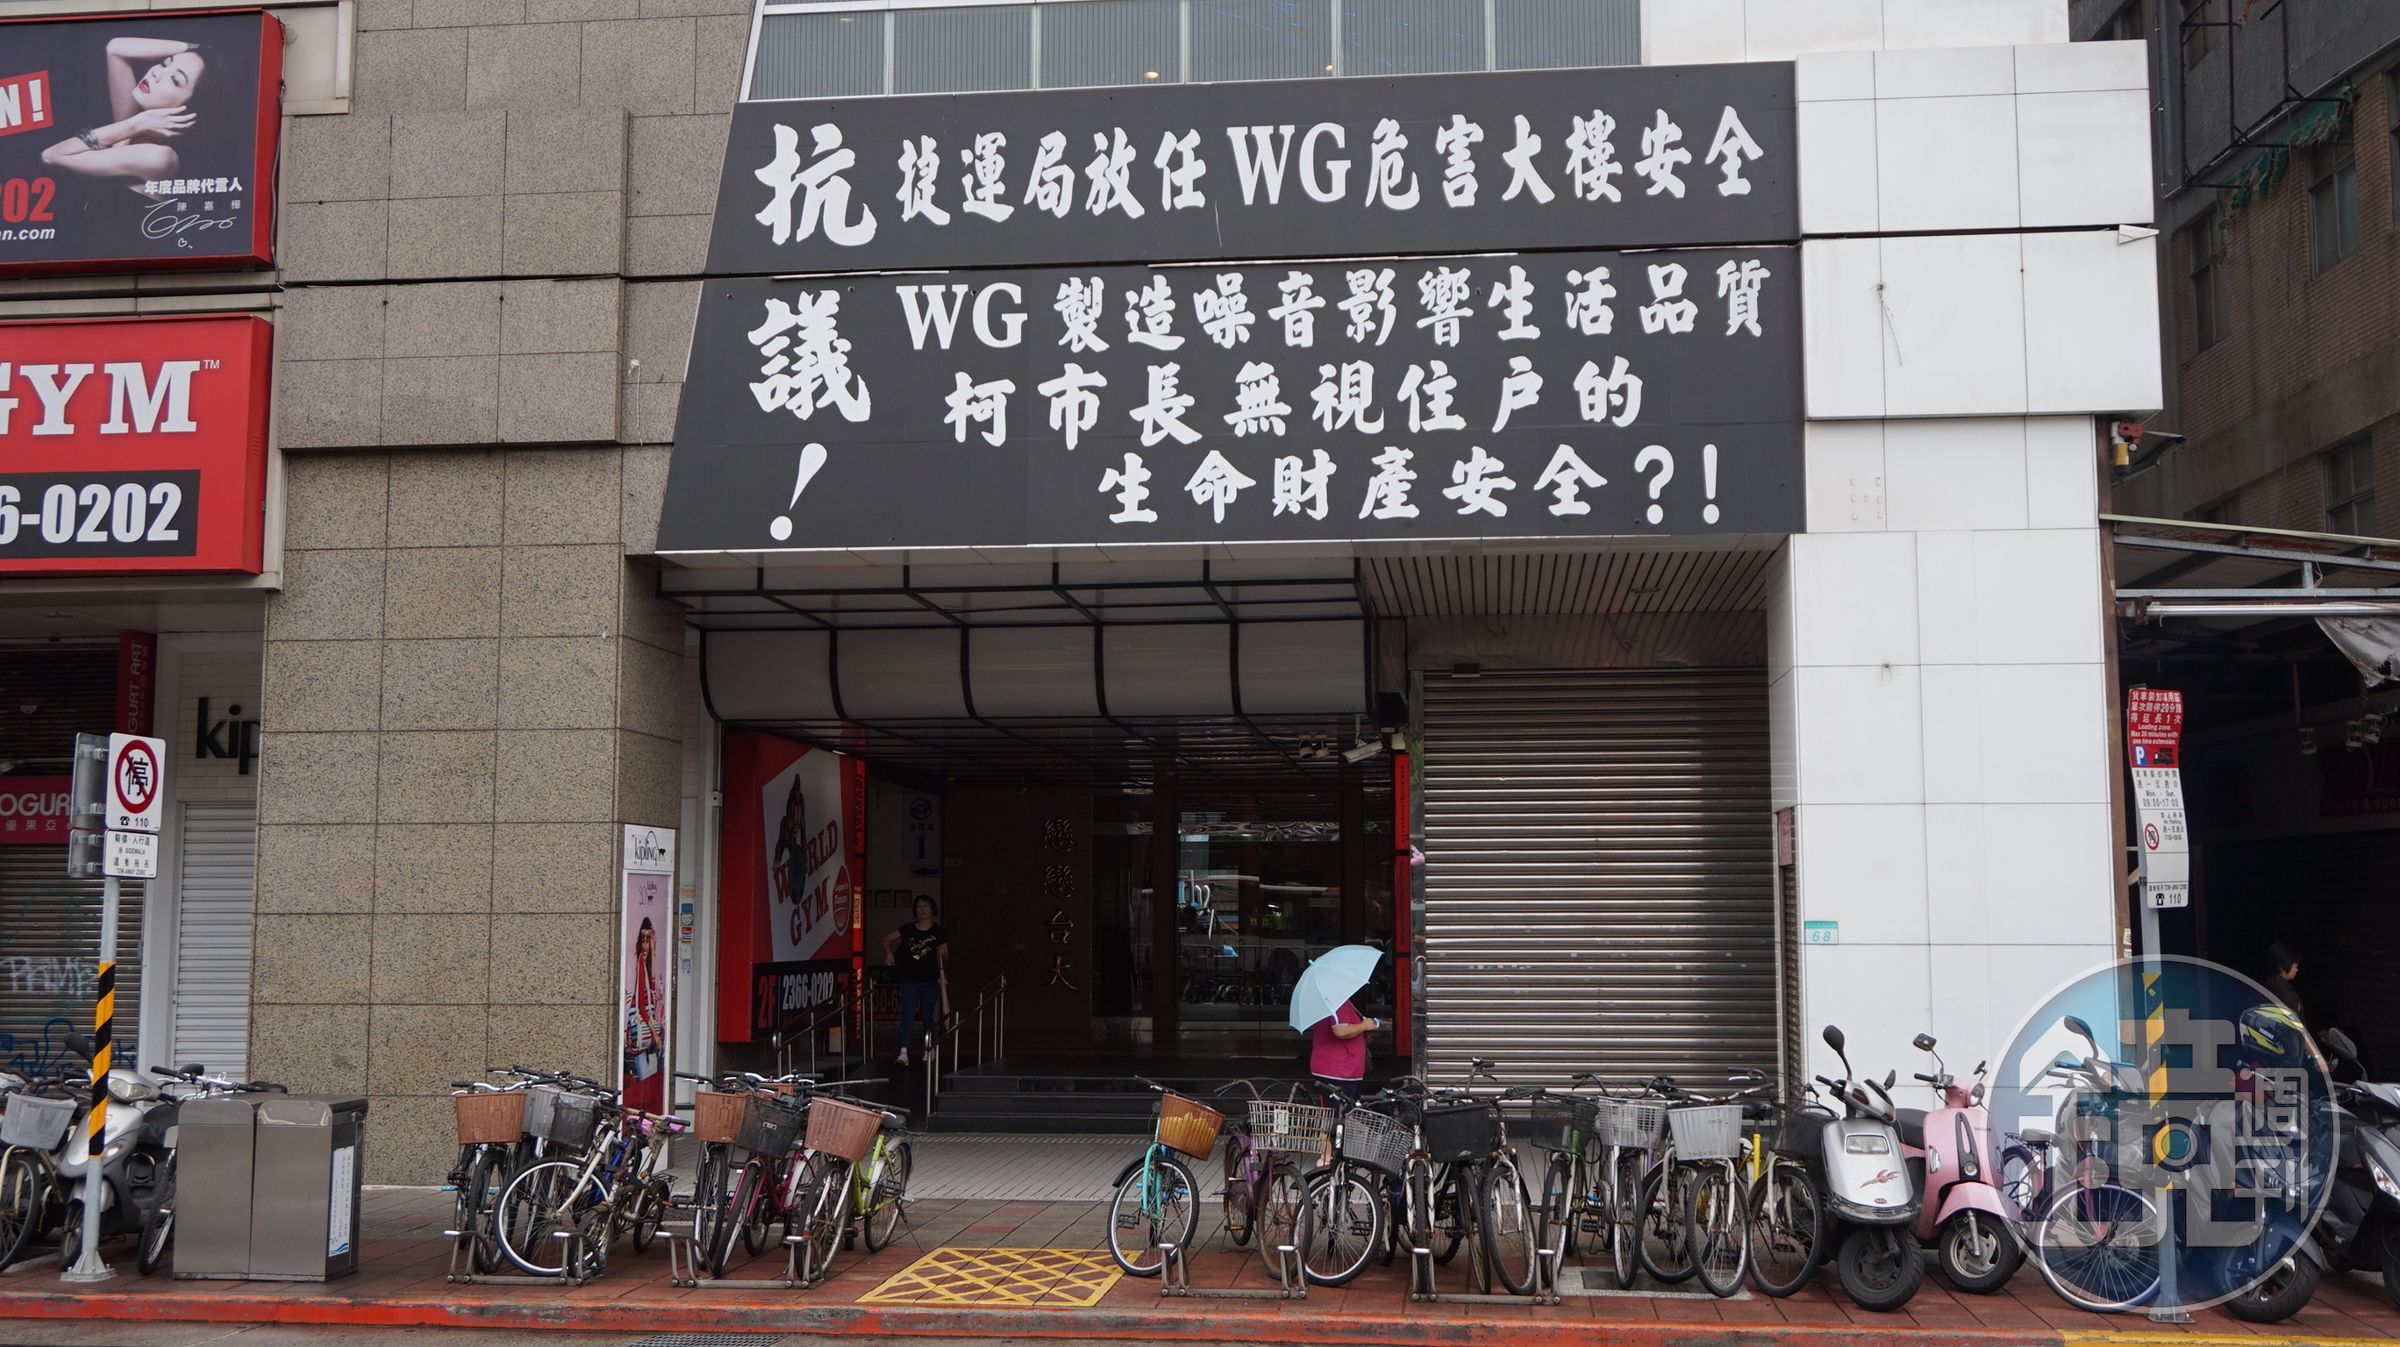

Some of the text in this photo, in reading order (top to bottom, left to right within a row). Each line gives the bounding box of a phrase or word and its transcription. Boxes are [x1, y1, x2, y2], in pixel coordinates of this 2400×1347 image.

[0, 177, 56, 223] 02
[144, 177, 243, 195] 年度品牌代言人
[0, 228, 55, 240] n.com
[944, 356, 1643, 450] 柯市長無視住戶的
[134, 817, 148, 828] 110
[790, 878, 830, 946] GYM
[1043, 816, 1079, 991] 戀戀台大
[2169, 894, 2181, 905] 110
[1813, 931, 1831, 941] 68
[758, 974, 778, 1029] 2F
[782, 971, 834, 1011] 2366-0202
